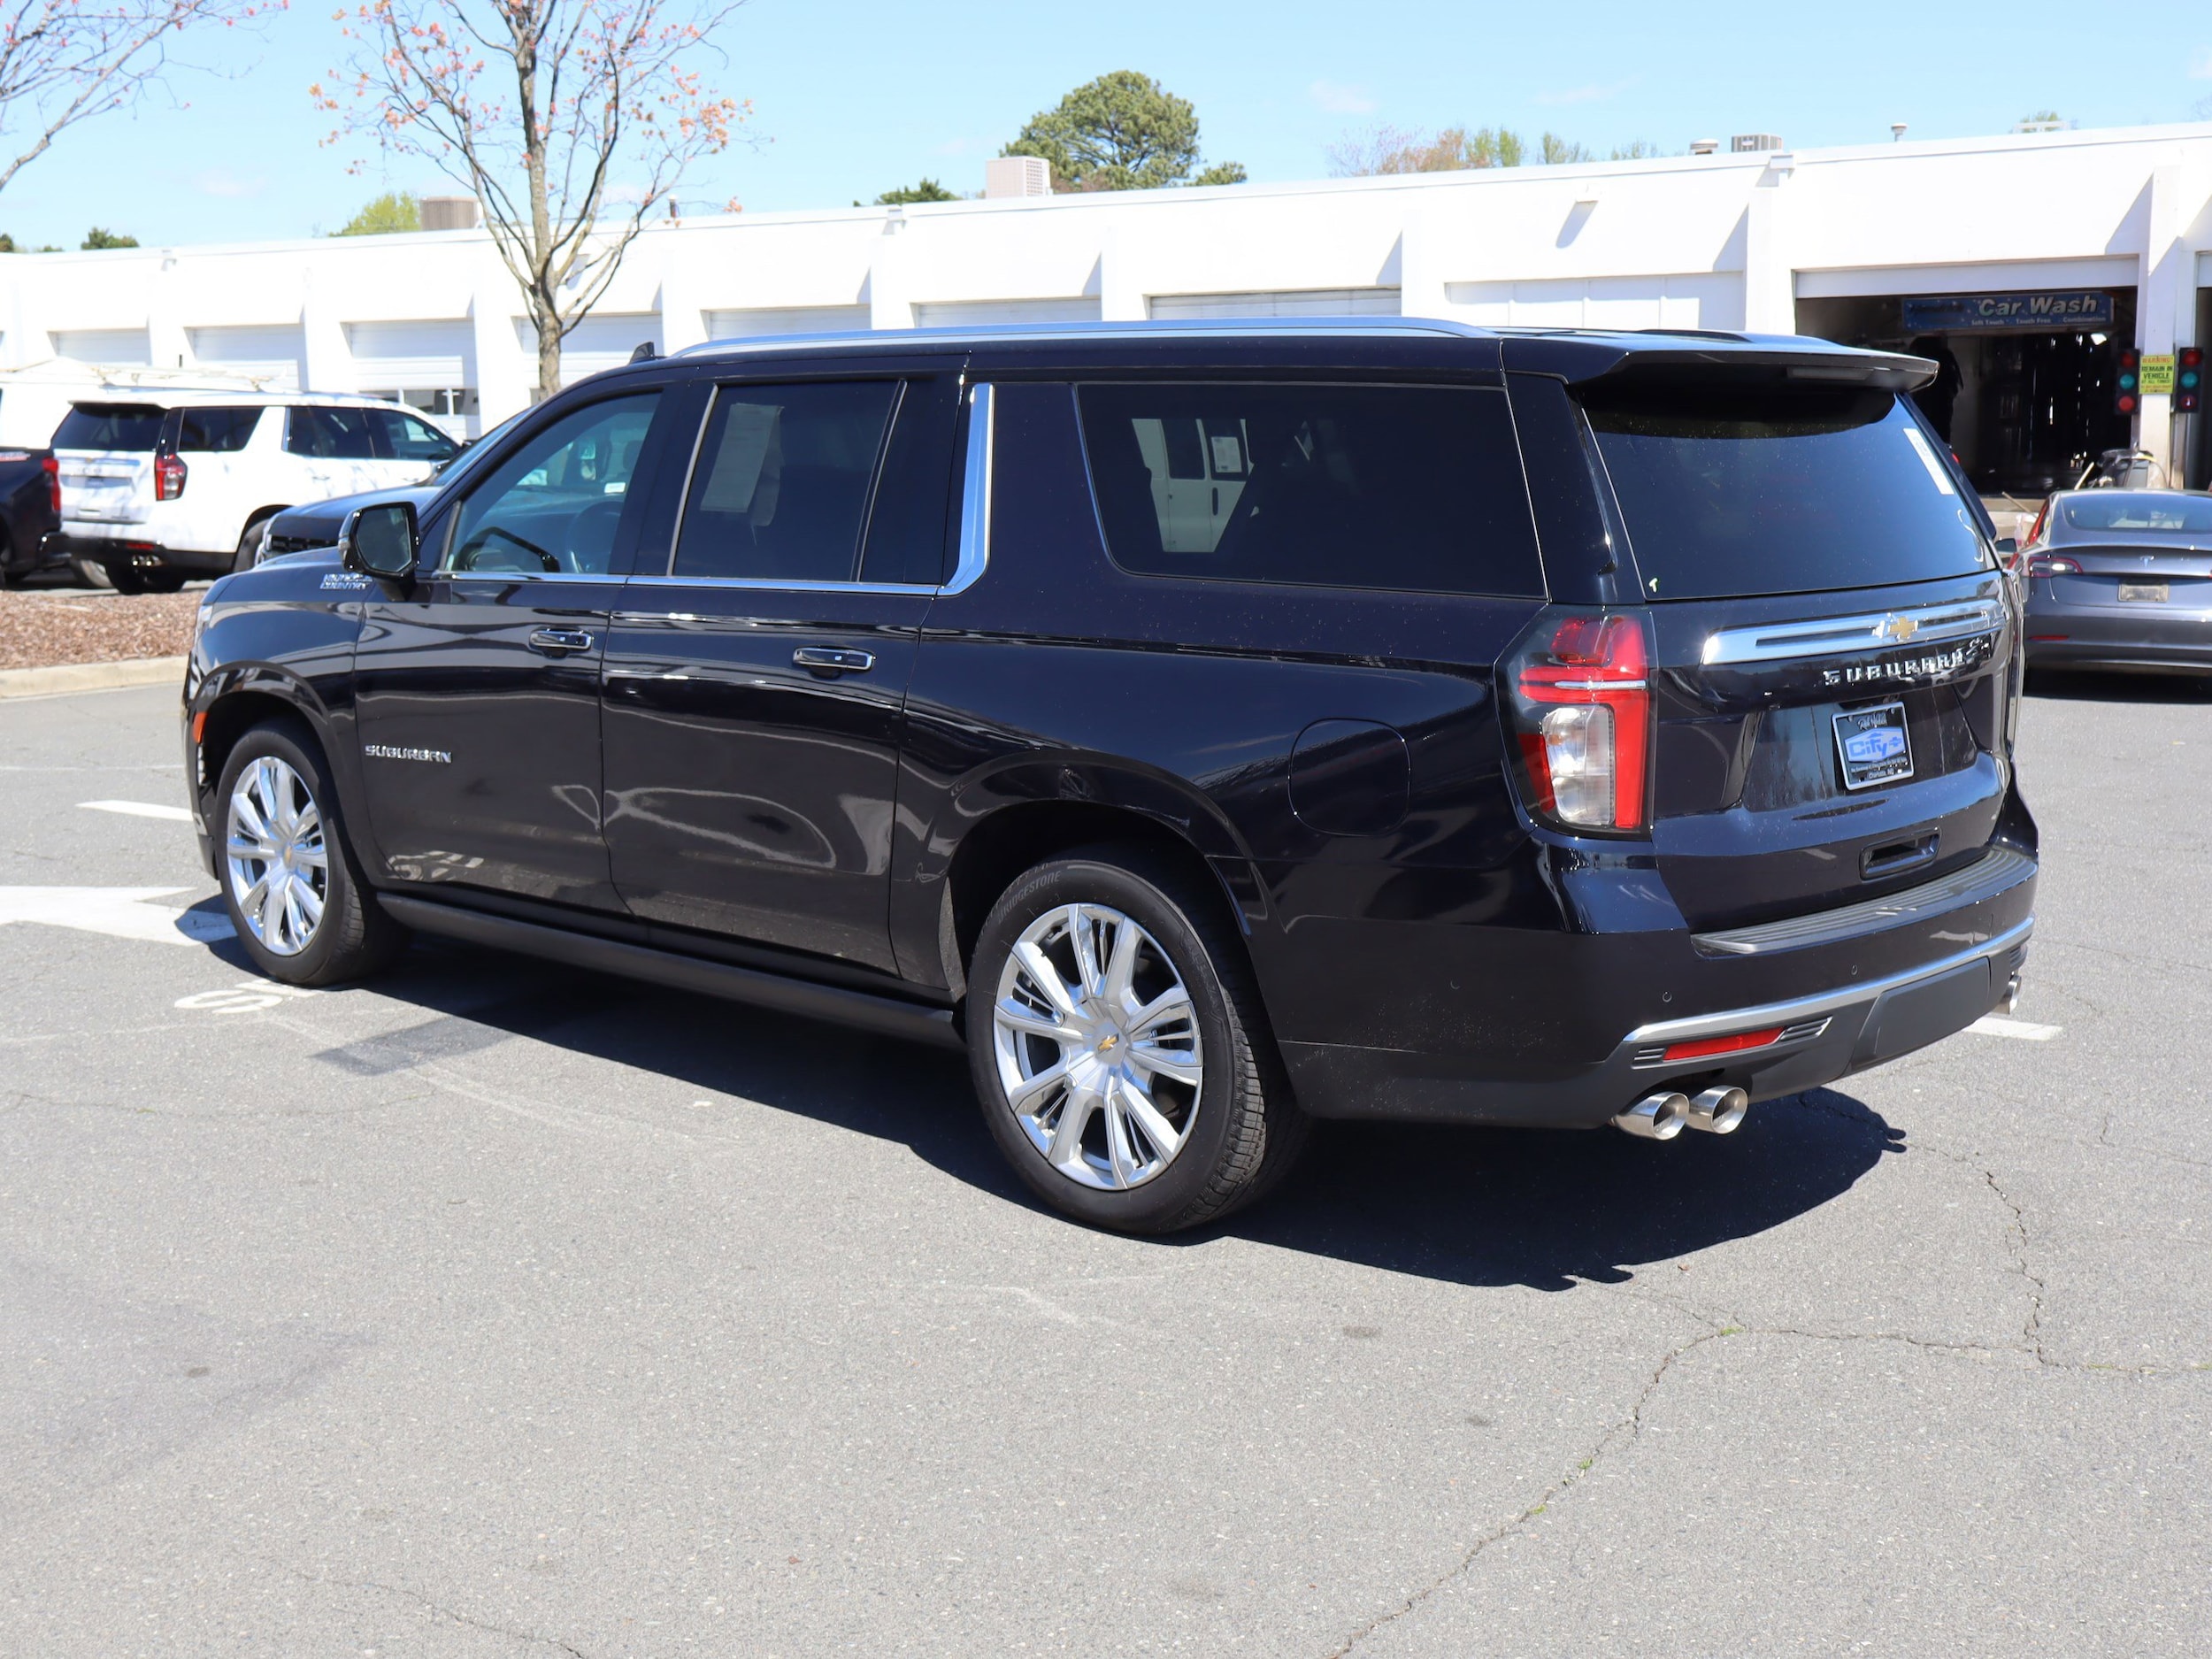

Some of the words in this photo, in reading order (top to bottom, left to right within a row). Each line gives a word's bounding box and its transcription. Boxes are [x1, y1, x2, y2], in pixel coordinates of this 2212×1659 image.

[1978, 298, 2022, 317] Car
[2031, 295, 2097, 314] Wash
[365, 744, 452, 764] SUBURBAN
[1848, 736, 1887, 757] City
